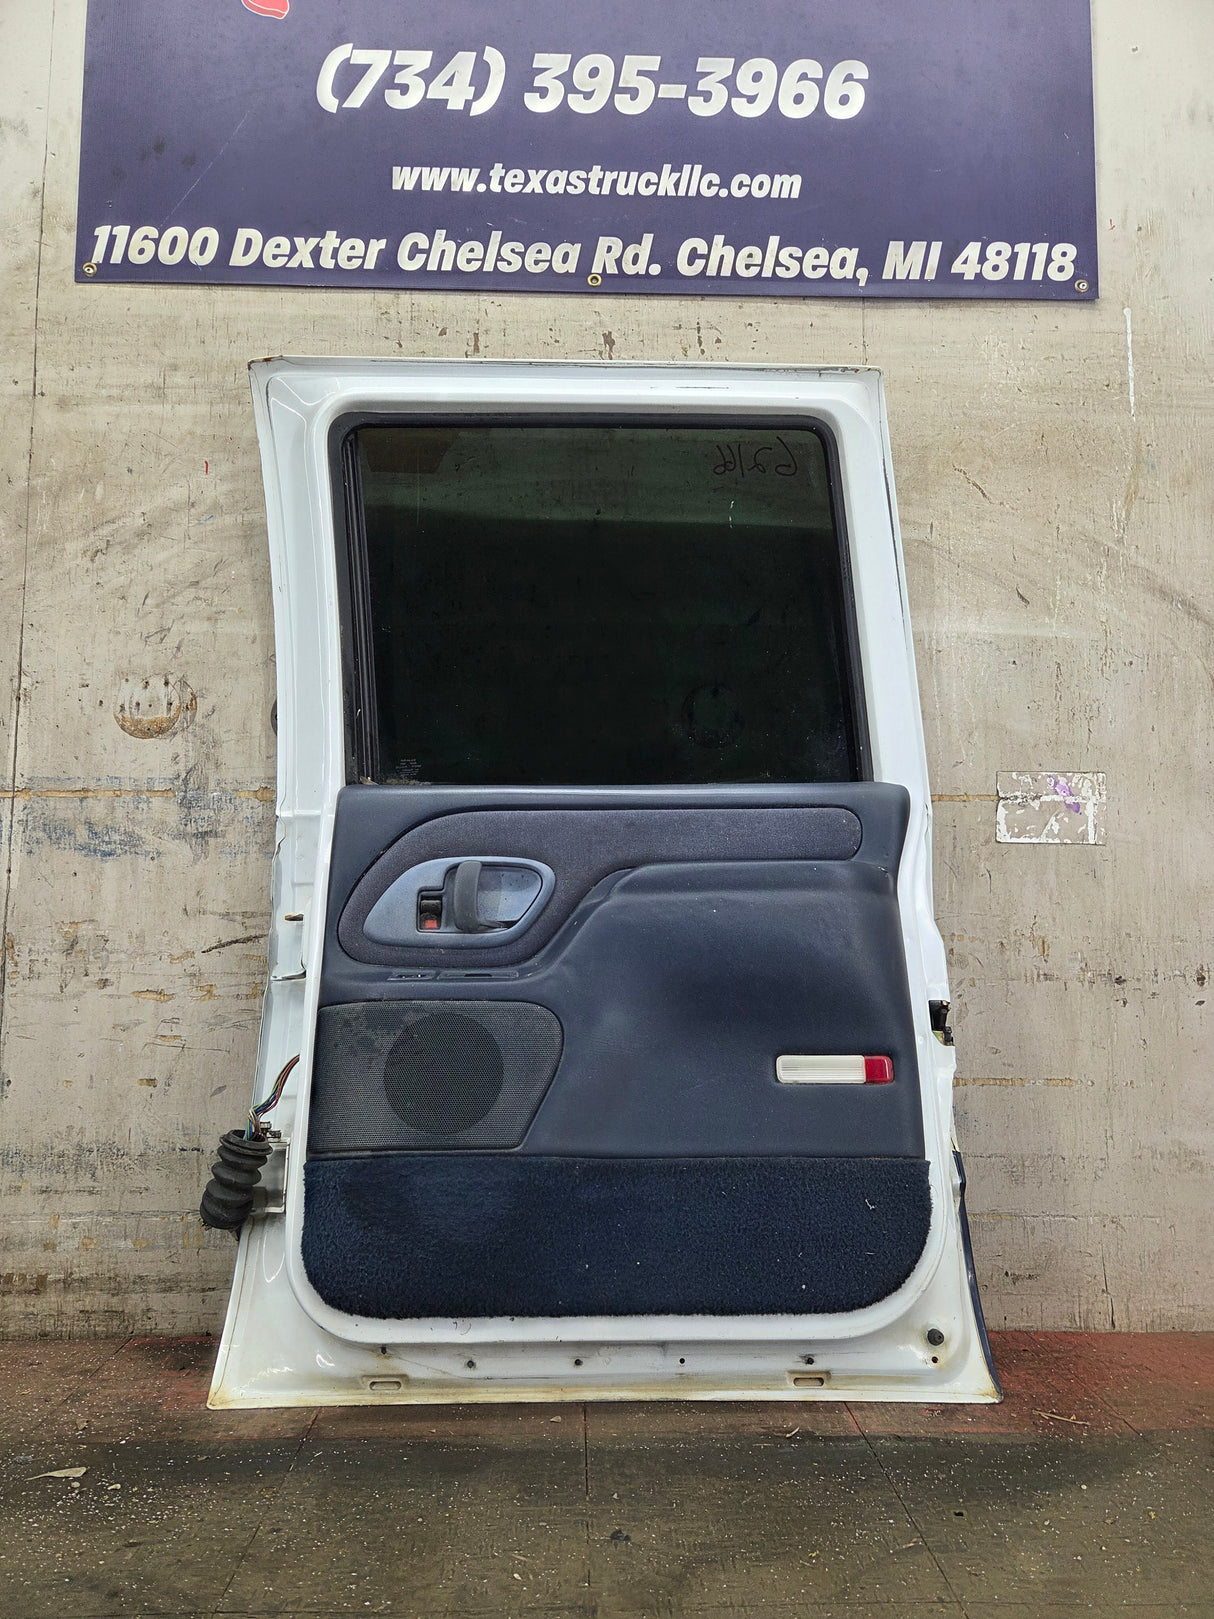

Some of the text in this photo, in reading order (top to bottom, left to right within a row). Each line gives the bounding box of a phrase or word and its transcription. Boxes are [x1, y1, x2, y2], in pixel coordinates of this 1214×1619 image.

[315, 43, 869, 120] (734) 395-3966
[391, 163, 803, 199] www.texastruckllc.com
[92, 225, 1078, 287] 11600 Dexter Chelsea Rd. Chelsea, MI 48118
